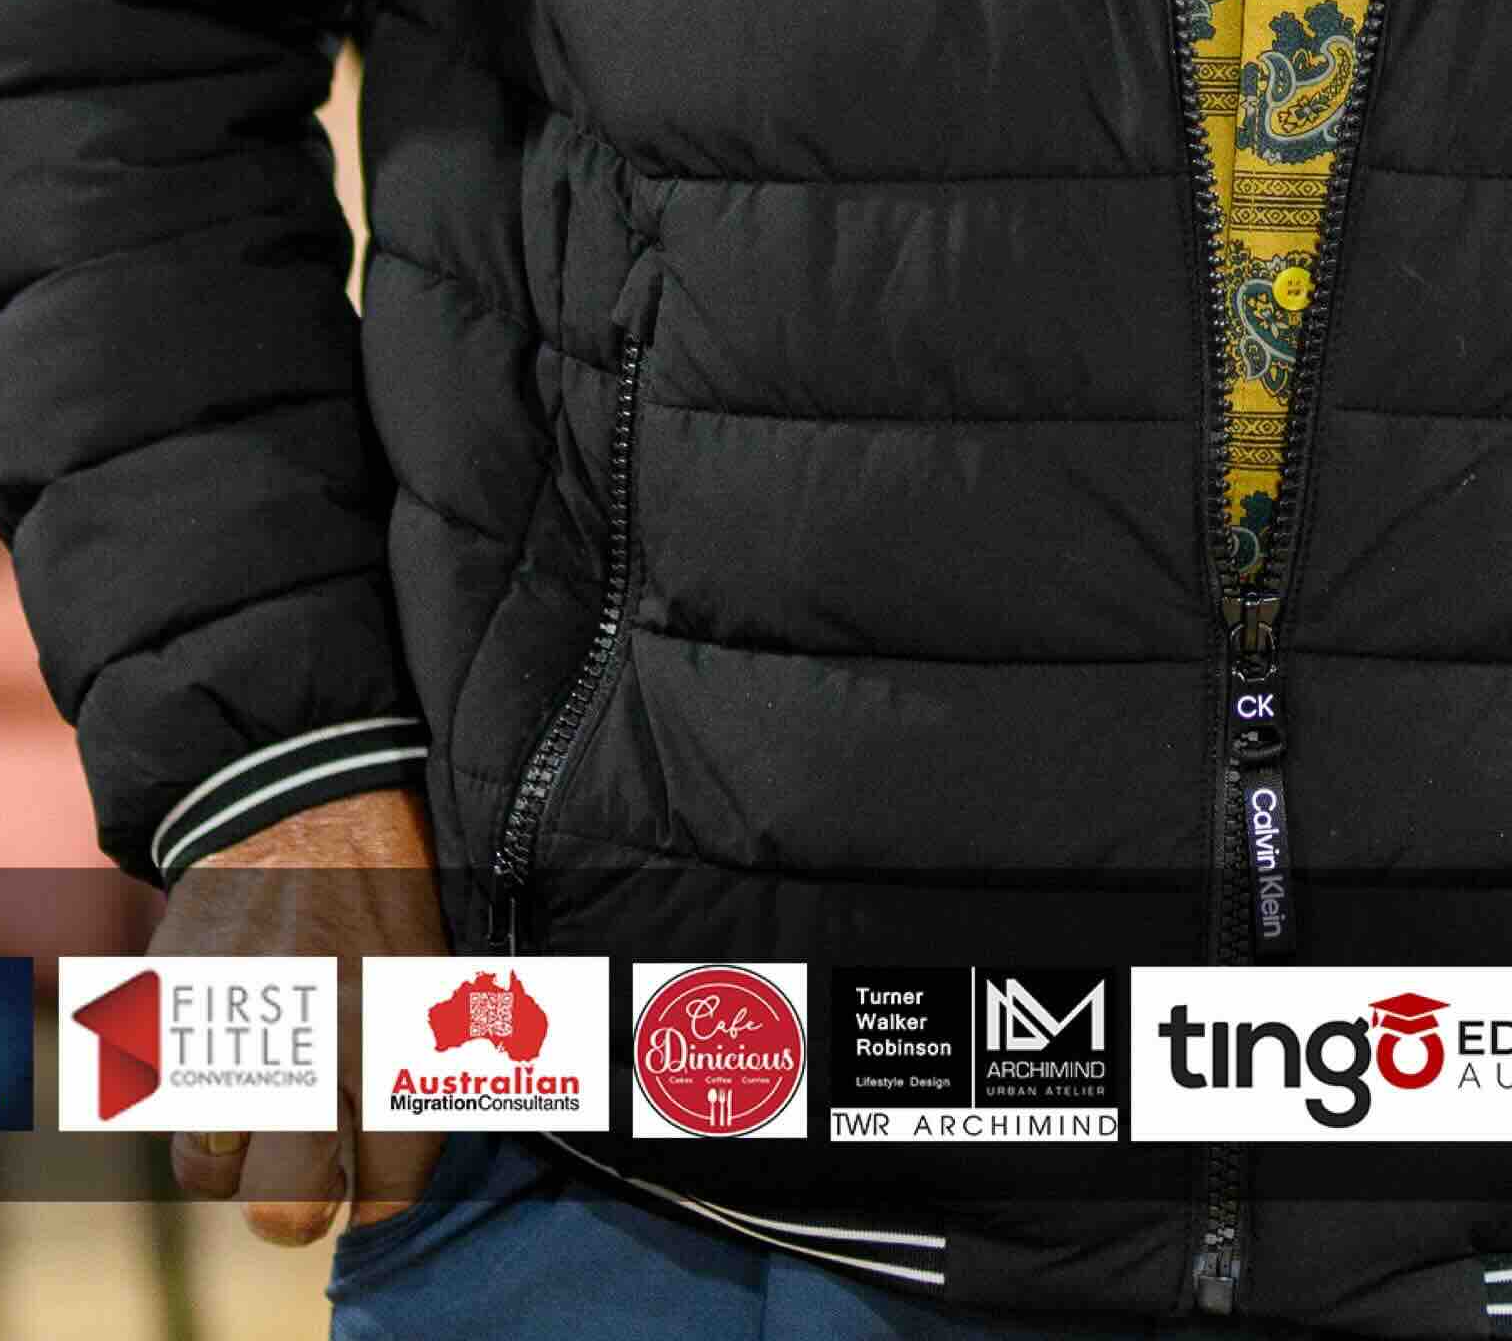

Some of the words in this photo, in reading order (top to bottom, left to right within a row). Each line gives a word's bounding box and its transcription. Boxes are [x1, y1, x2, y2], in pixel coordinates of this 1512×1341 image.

[1237, 694, 1275, 718] CK
[1251, 788, 1280, 871] Calvin
[1259, 875, 1286, 938] Klein
